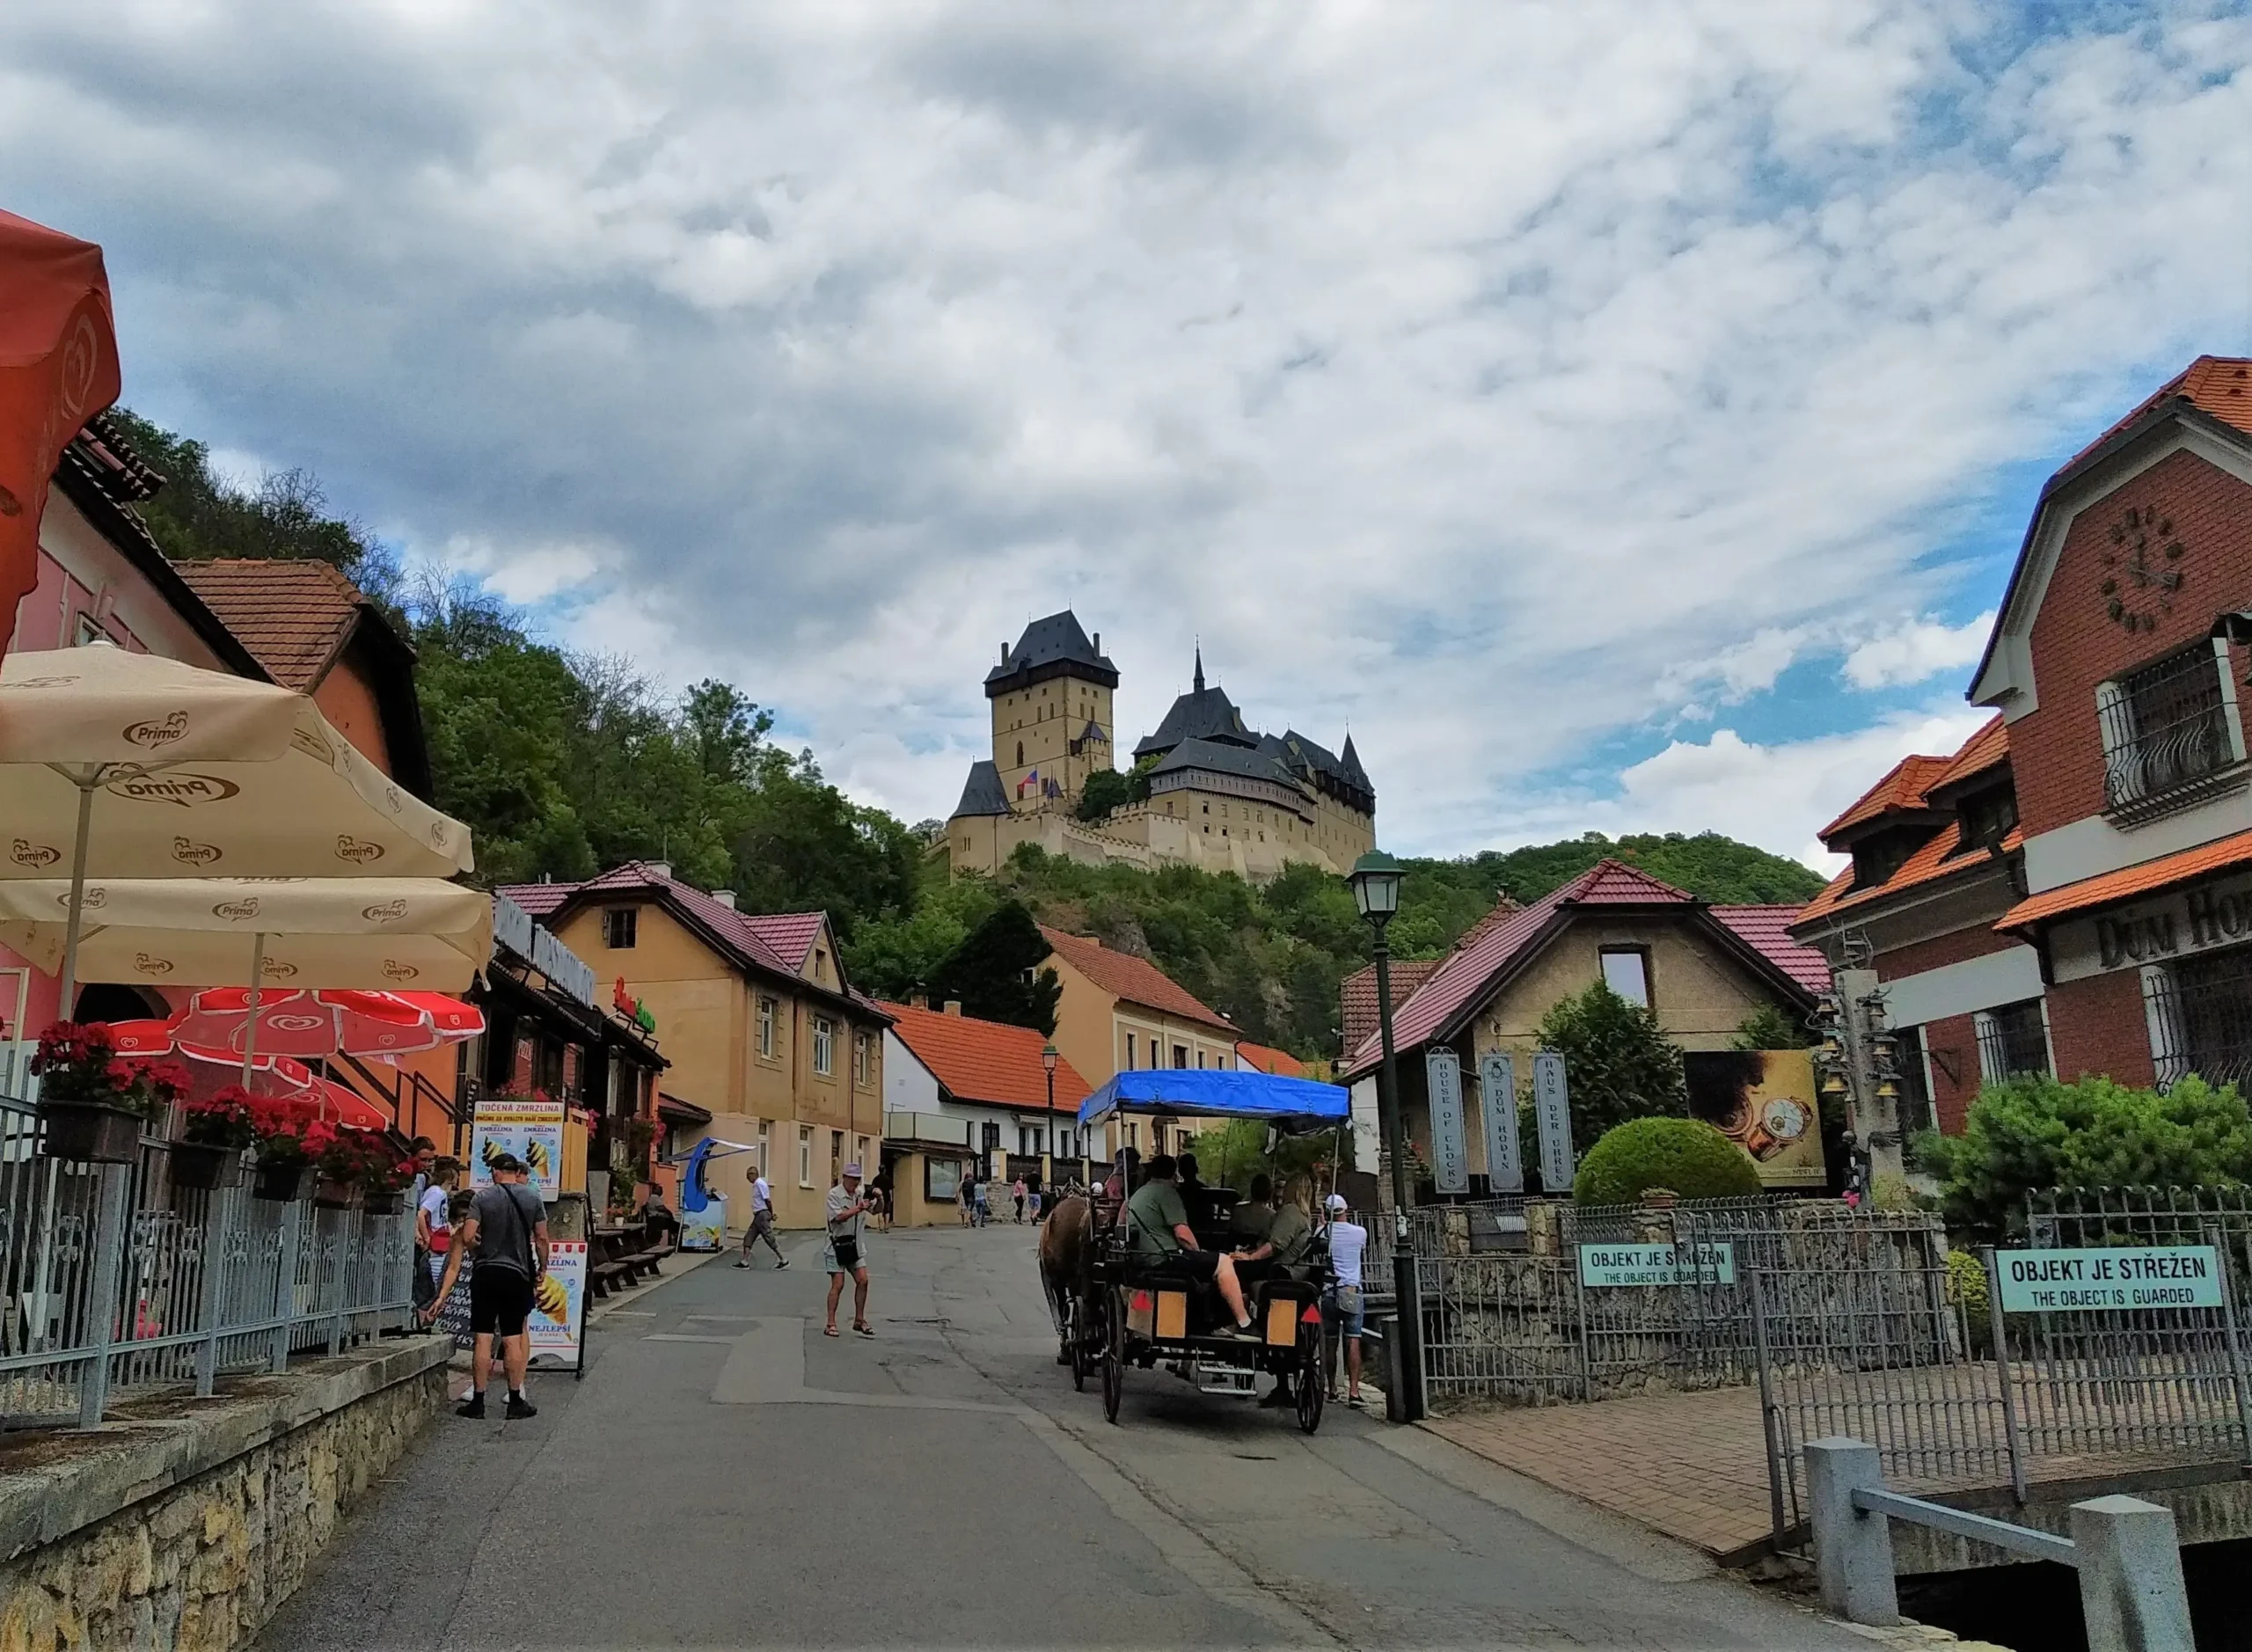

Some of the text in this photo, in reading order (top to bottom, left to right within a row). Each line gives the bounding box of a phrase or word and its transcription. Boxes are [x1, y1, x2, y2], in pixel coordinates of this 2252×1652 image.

[137, 727, 181, 740] Prima
[223, 906, 253, 916] Prima
[371, 908, 402, 917] Prima
[481, 1103, 513, 1112] TOČENÁ
[1439, 1063, 1456, 1186] HOUSE OF CLOCKS
[1549, 1105, 1559, 1130] DER
[1498, 1125, 1509, 1169] HODIN
[1552, 1140, 1563, 1183] UHREN
[1591, 1252, 1641, 1267] OBJEKT
[1646, 1252, 1661, 1266] JE
[2011, 1252, 2206, 1282] OBJEKT JE STŘEŽEN
[1604, 1273, 1621, 1283] THE
[1625, 1272, 1656, 1283] OBJECT
[1660, 1272, 1668, 1283] IS
[2032, 1288, 2194, 1306] THE OBJECT IS GUARDED
[528, 1324, 571, 1333] NEJLEPŠÍ
